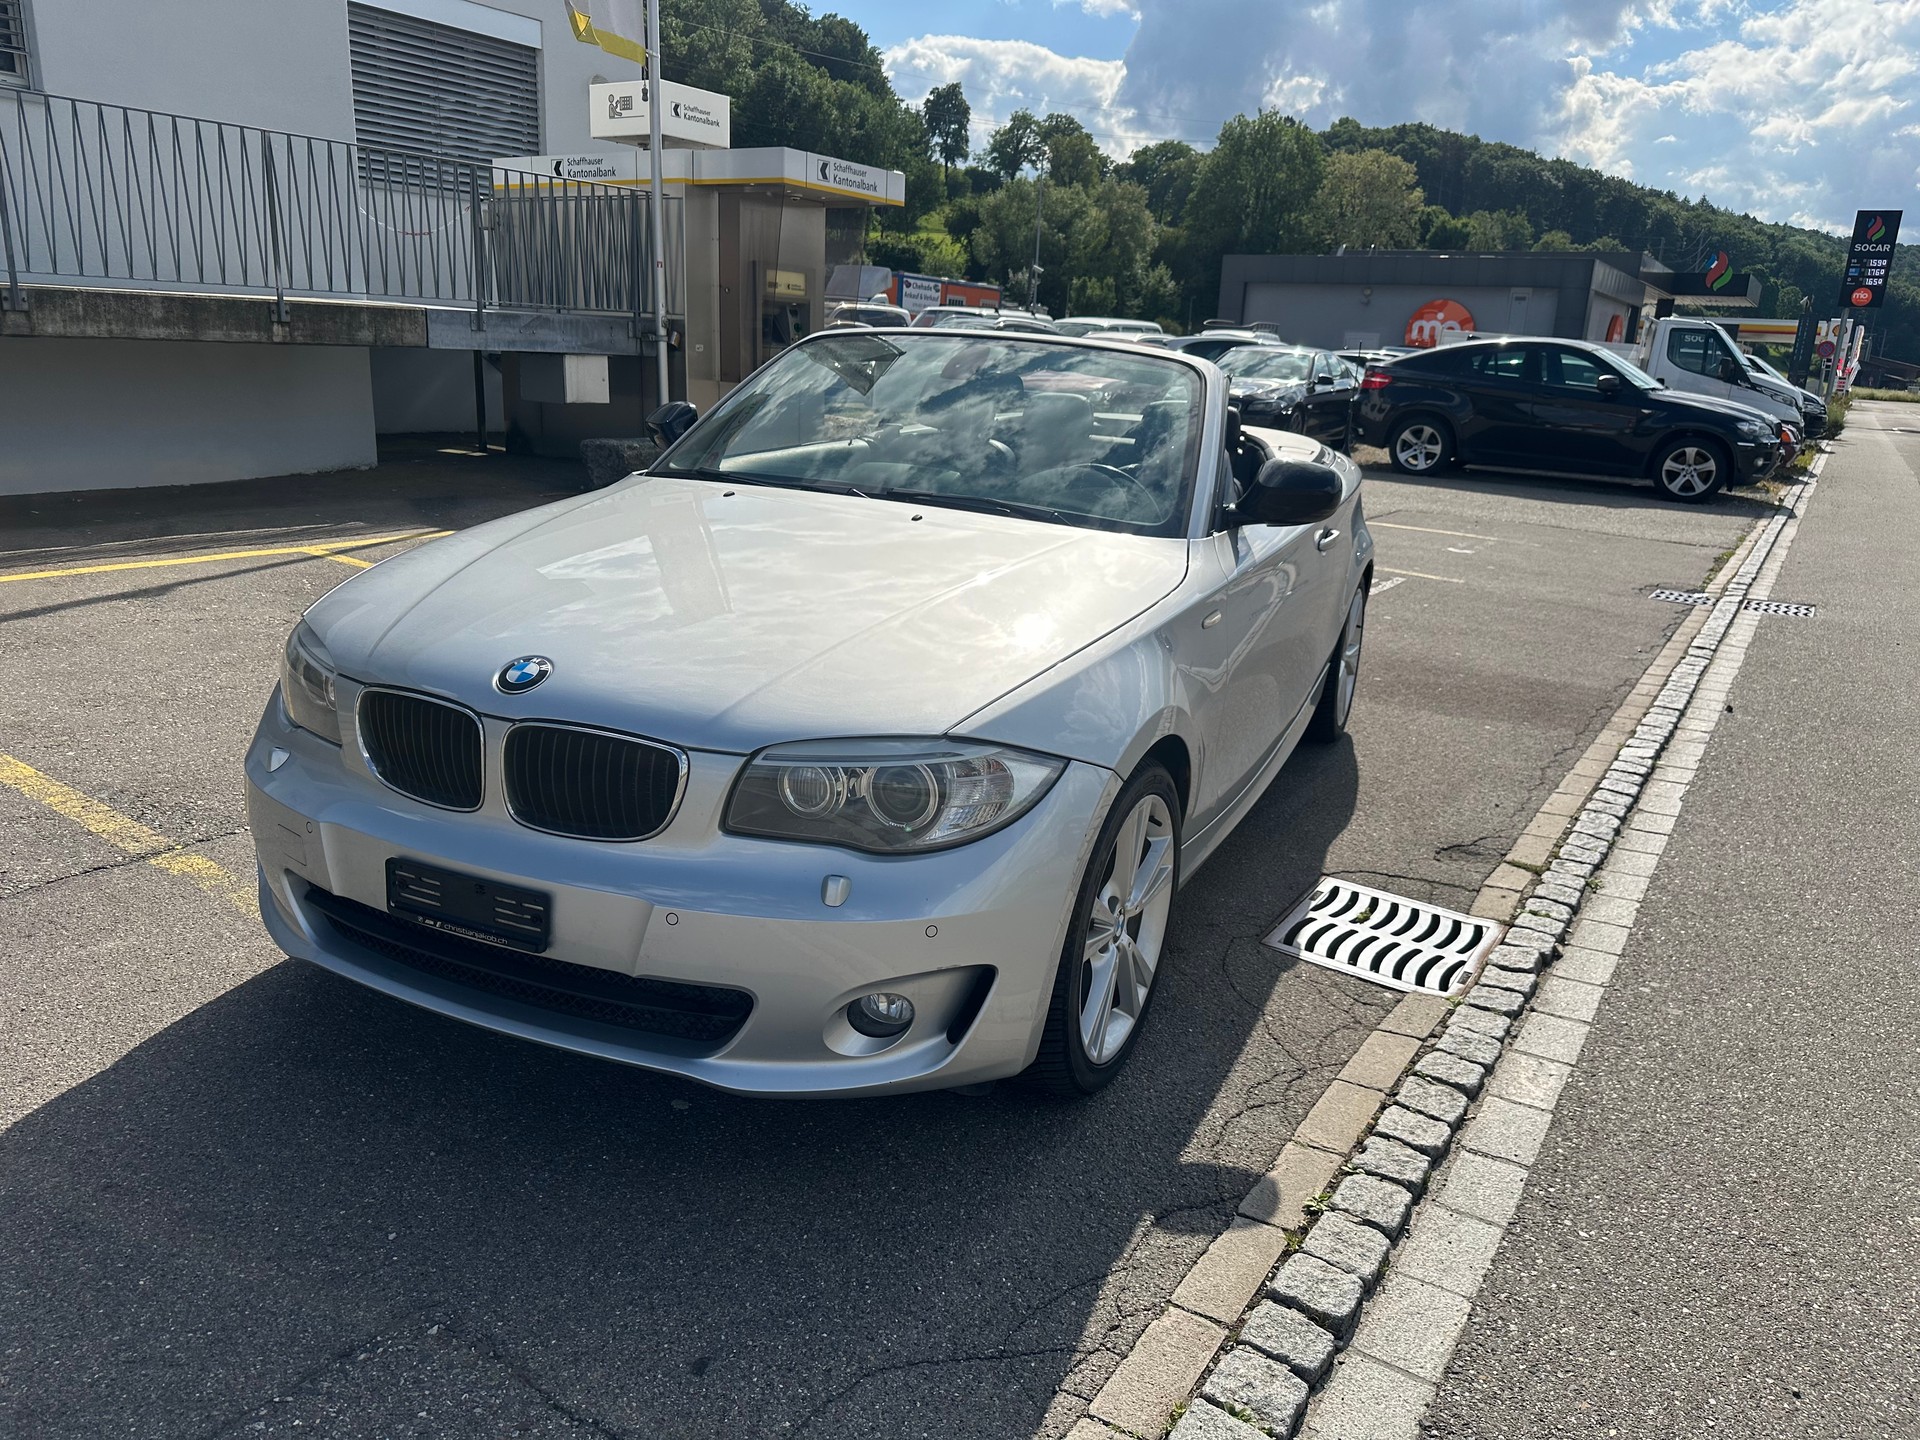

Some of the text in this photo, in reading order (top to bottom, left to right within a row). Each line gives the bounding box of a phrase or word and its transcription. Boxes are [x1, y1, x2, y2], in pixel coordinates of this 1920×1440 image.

[683, 104, 711, 117] Schaffhauser
[683, 113, 720, 127] Kantonalbank
[567, 157, 603, 166] Schaffhauser
[567, 166, 616, 178] Kantonalbank
[833, 162, 867, 177] Schaffhauser
[832, 173, 878, 192] Kantonalbank
[1854, 243, 1891, 252] SOCAR
[1852, 290, 1869, 299] mio
[443, 922, 508, 945] christianjakob.ch
